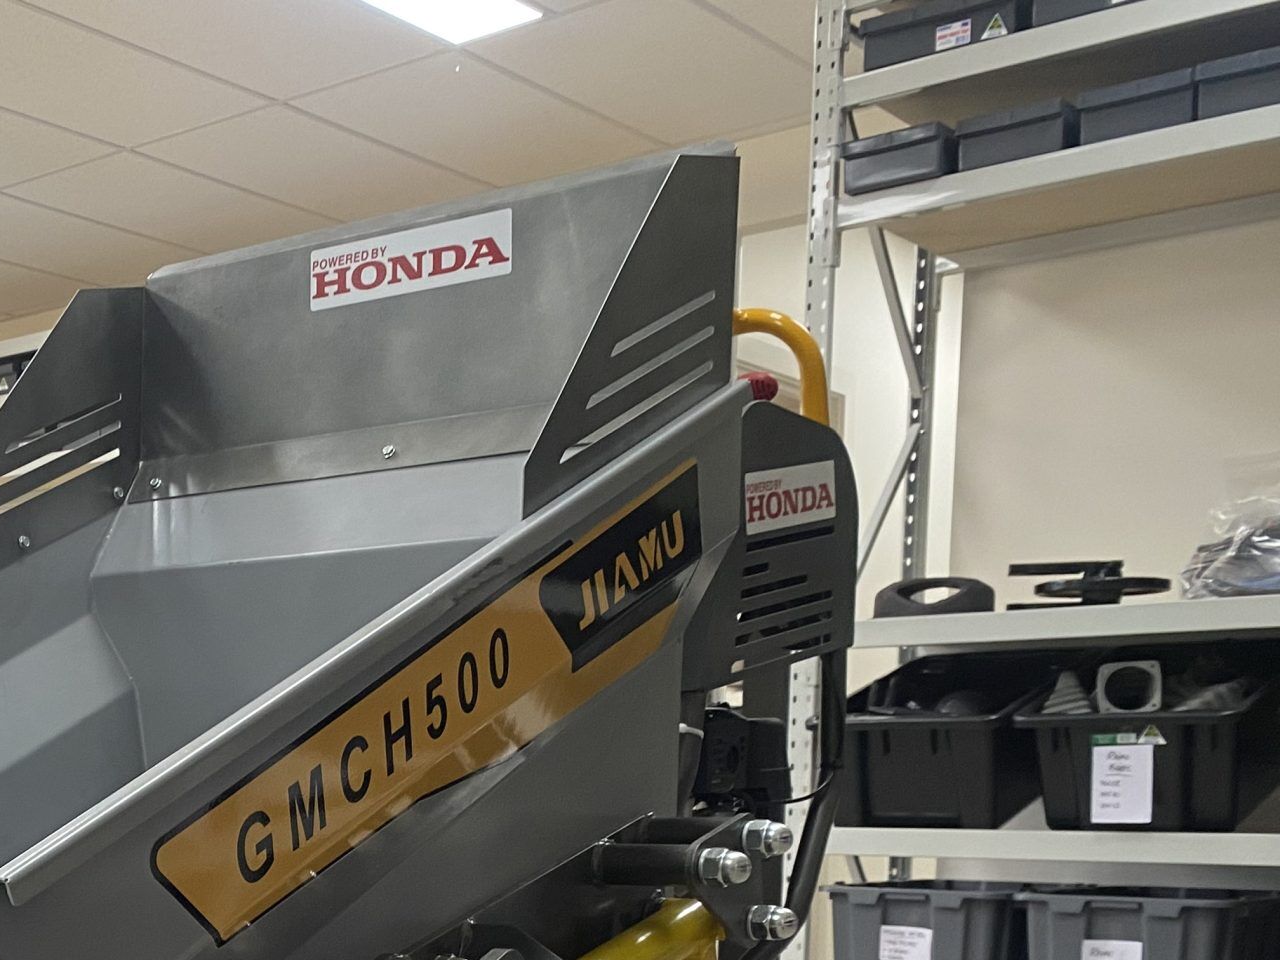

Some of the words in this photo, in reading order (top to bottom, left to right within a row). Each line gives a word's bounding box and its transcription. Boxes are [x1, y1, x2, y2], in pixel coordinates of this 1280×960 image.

[312, 250, 369, 272] POWERED
[371, 246, 387, 259] BY
[312, 237, 510, 299] HONDA
[746, 483, 833, 523] HONDA
[579, 510, 684, 631] JIAMU
[236, 628, 509, 883] GMCH500
